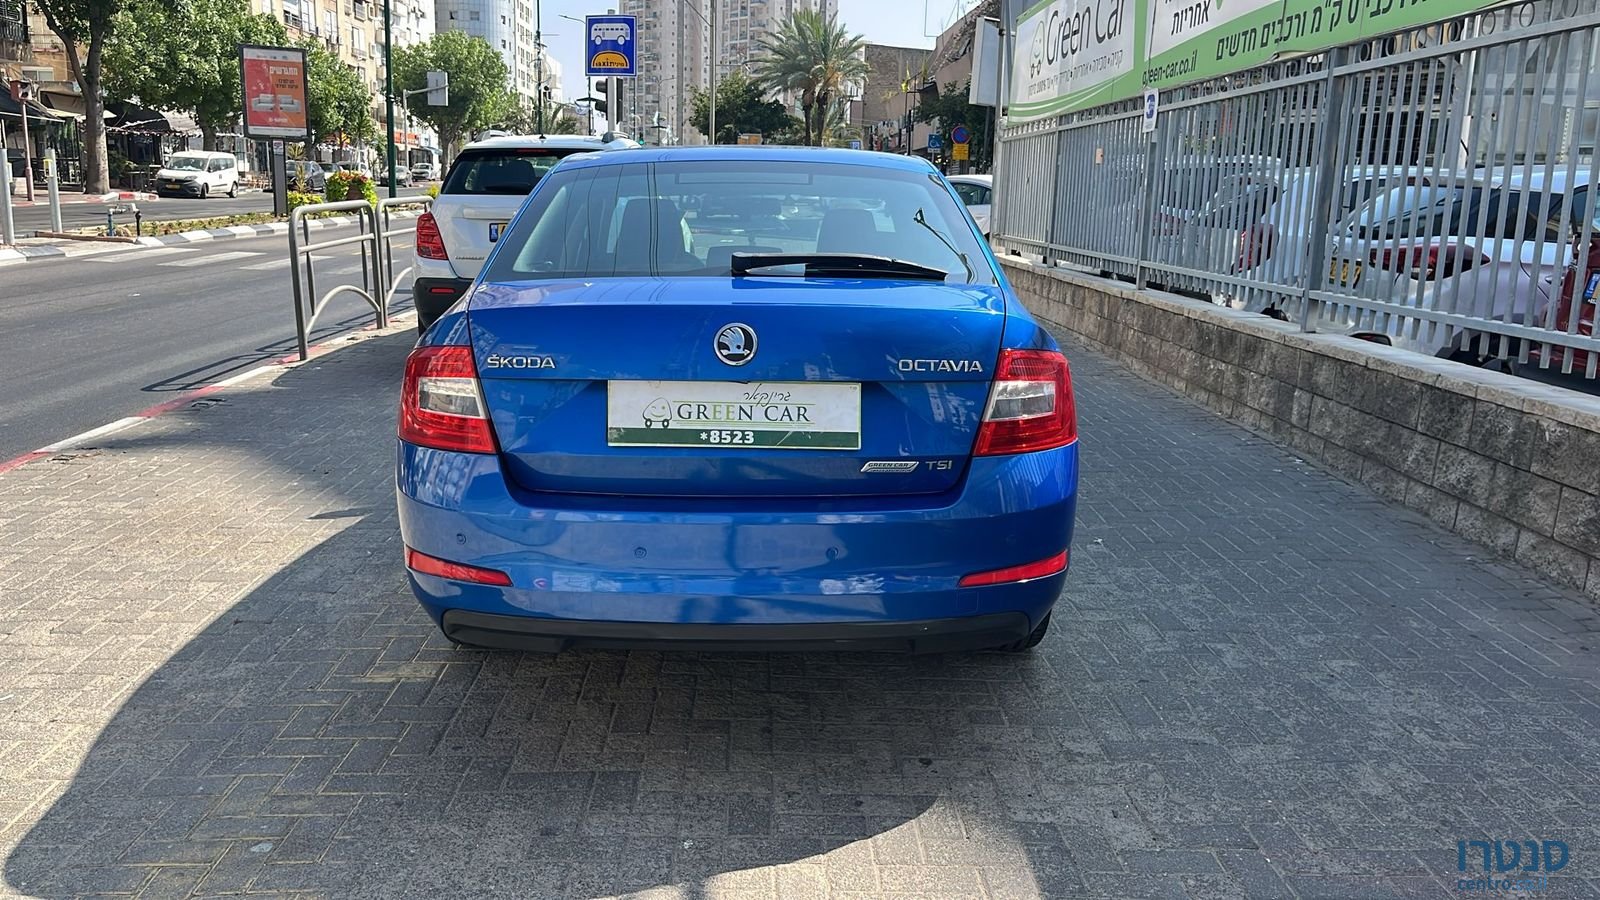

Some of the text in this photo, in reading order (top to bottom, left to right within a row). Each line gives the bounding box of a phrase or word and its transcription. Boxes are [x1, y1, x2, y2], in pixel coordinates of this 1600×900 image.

[1171, 0, 1211, 36] אחריות
[1260, 10, 1307, 49] ורכבים
[1046, 6, 1091, 66] Green
[1216, 27, 1257, 61] חדשים
[1142, 49, 1198, 87] green-car.co.il
[487, 353, 556, 369] ŠKODA
[898, 359, 984, 373] OCTAVIA
[677, 403, 811, 422] GREEN CAR
[925, 460, 953, 470] TSI
